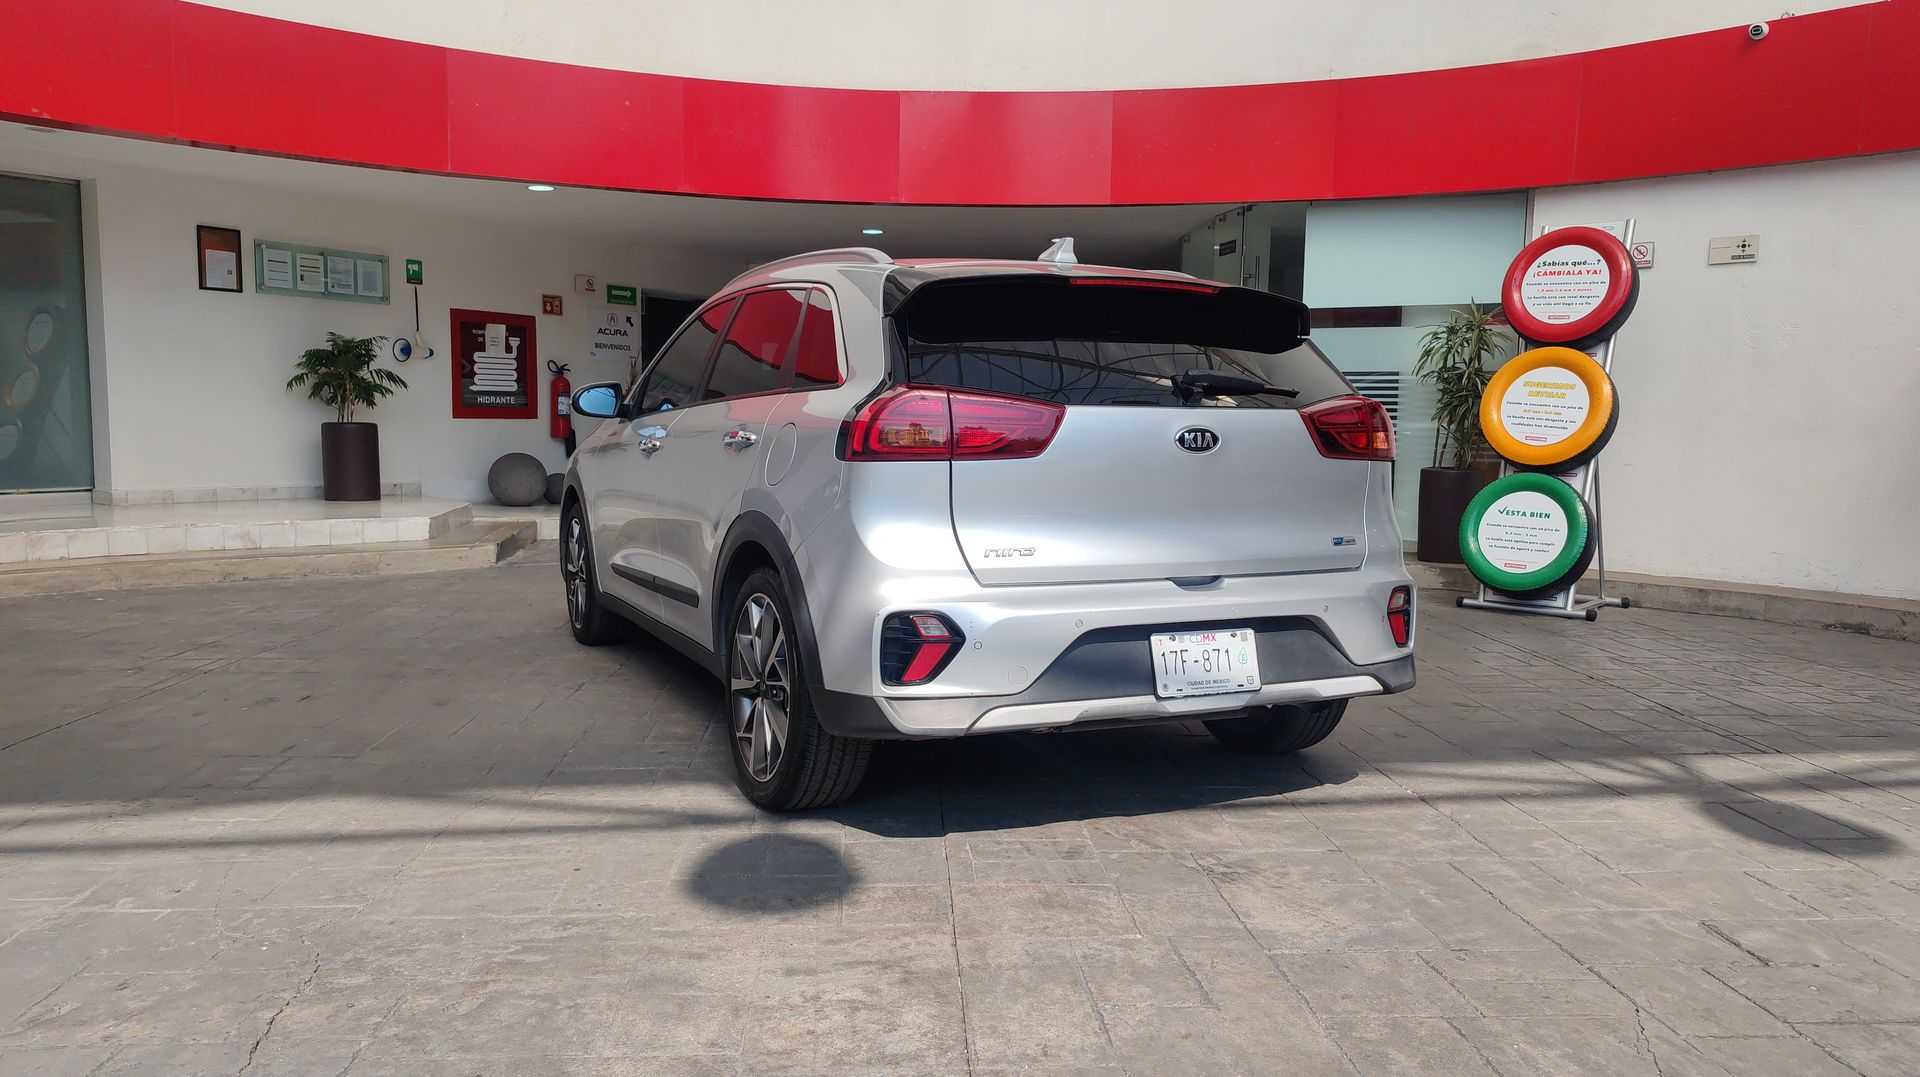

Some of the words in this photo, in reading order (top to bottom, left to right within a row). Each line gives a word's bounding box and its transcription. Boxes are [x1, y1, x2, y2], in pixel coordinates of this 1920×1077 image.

[597, 328, 629, 337] ACURA
[594, 342, 632, 352] BIENVENIDOS
[1527, 390, 1567, 399] REVISAR
[477, 395, 516, 404] HIDRANTE
[1183, 432, 1214, 448] KIA
[1529, 511, 1551, 519] BIEN
[1189, 633, 1217, 644] CDMX
[1161, 647, 1232, 676] 17F-871
